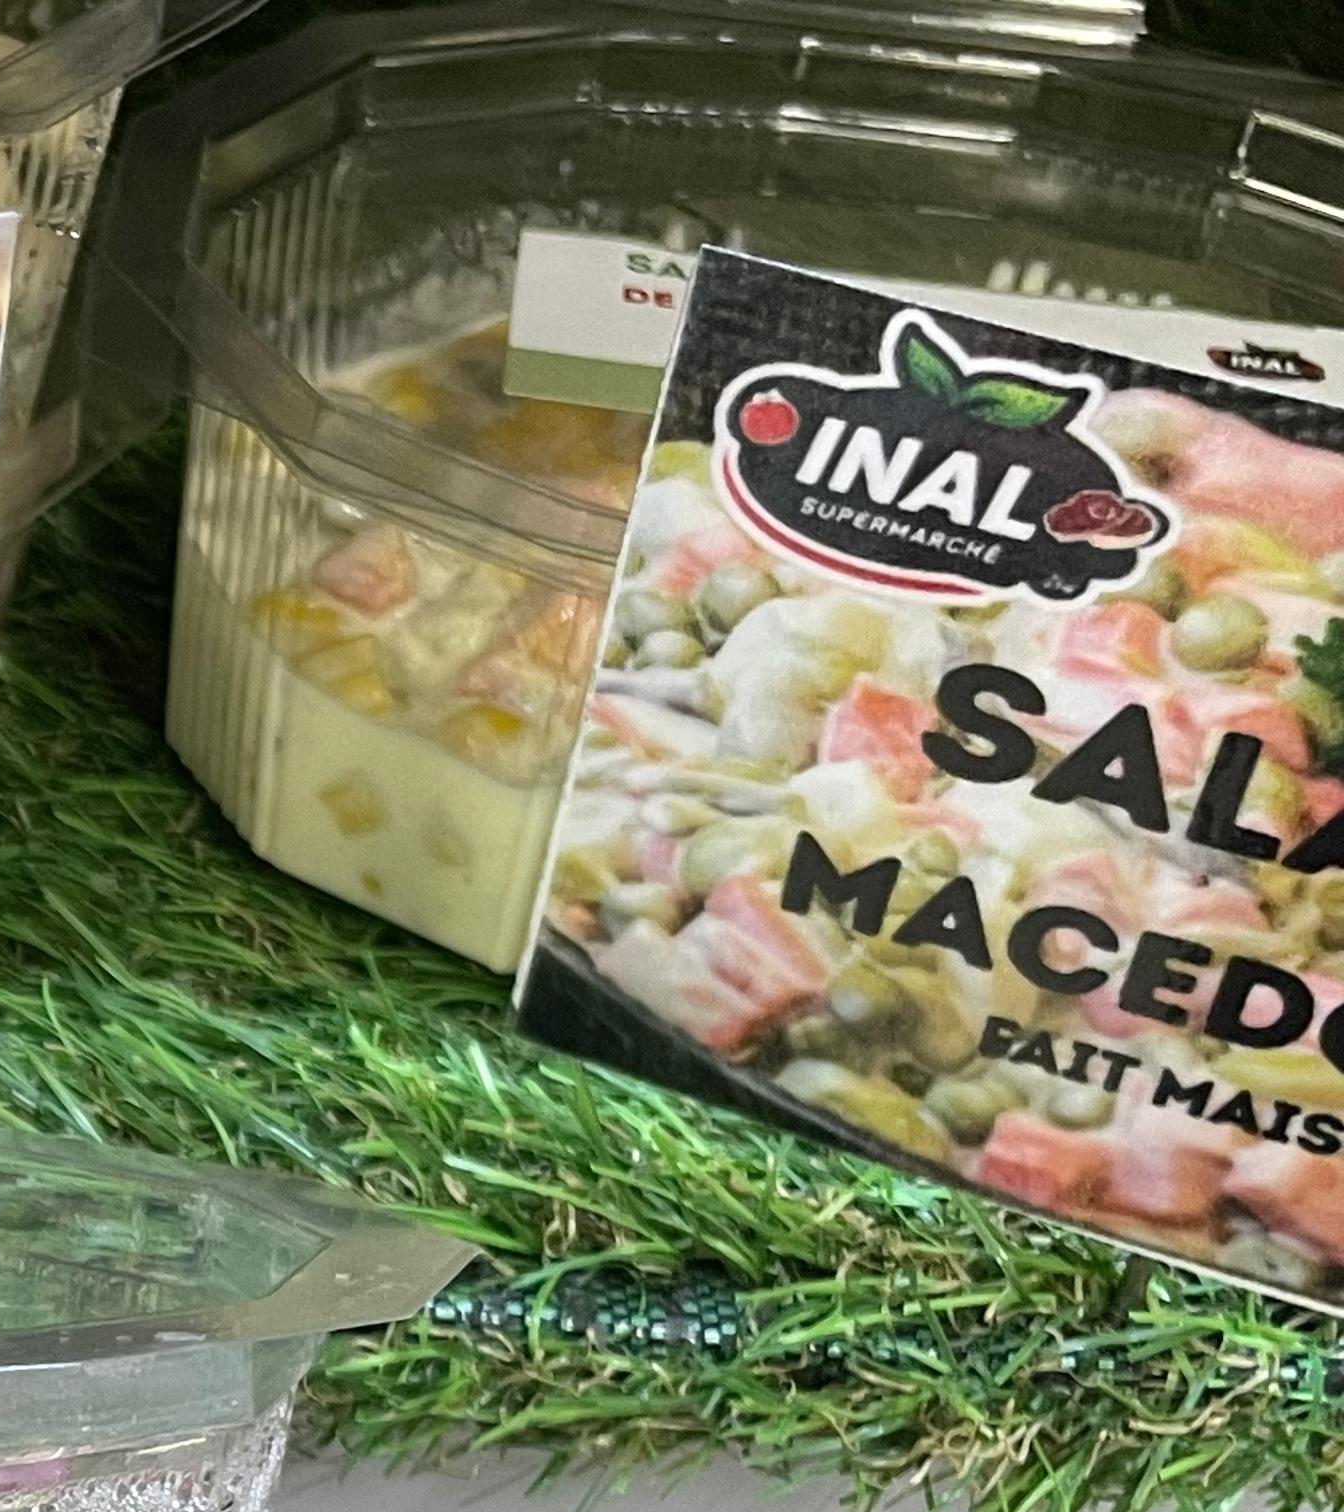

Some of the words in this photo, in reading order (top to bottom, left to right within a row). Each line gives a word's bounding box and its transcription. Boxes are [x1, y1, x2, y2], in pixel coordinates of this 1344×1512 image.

[795, 416, 1037, 542] INAL
[798, 496, 1005, 565] SUPERMARCHÉ
[781, 830, 1344, 1075] MACED
[979, 1015, 1141, 1092] FAIT
